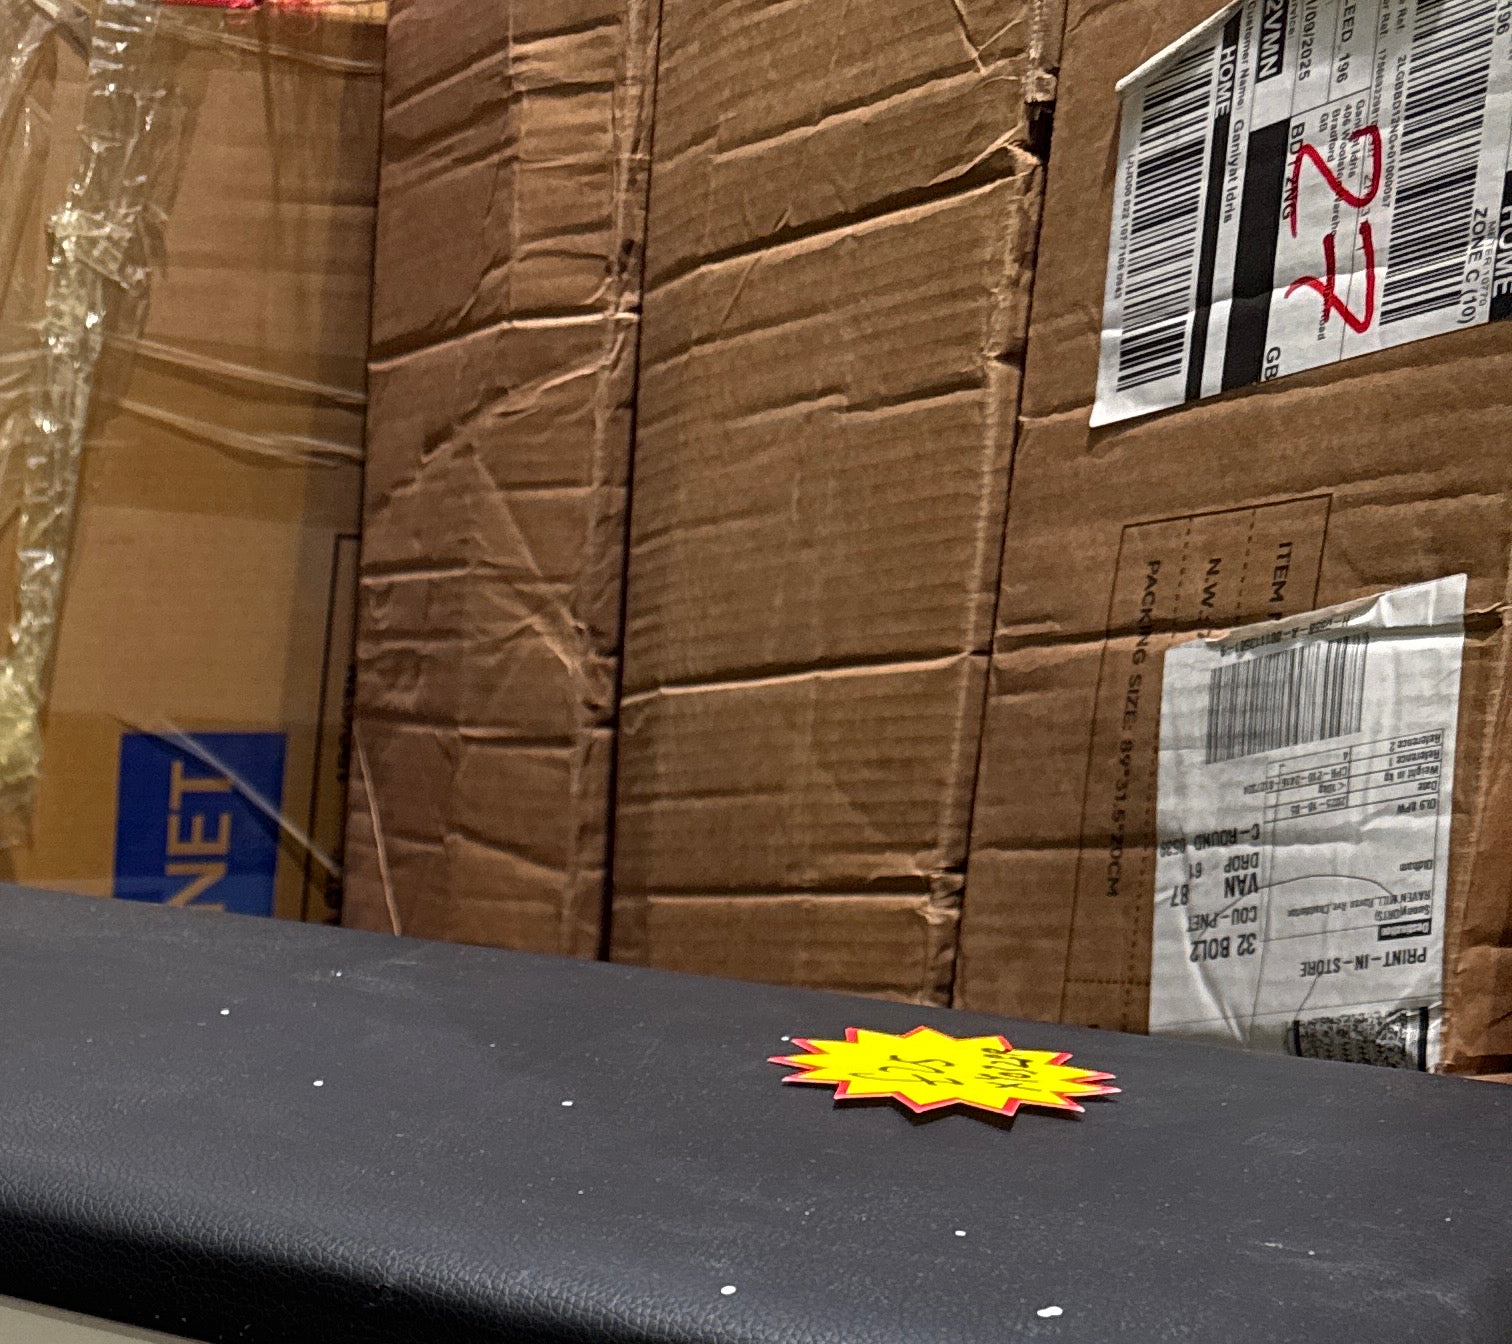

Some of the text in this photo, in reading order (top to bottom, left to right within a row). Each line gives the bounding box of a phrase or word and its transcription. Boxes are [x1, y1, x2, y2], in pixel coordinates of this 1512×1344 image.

[1214, 46, 1236, 121] HOME
[1223, 186, 1239, 224] Idris
[1285, 125, 1381, 333] 27
[1457, 208, 1487, 325] ZONE C (10)
[1264, 346, 1282, 379] GB
[1269, 541, 1292, 602] ITEM
[1131, 559, 1161, 666] PACKING
[1223, 852, 1260, 873] DROP
[1224, 872, 1260, 899] VAN
[1237, 933, 1257, 956] 32
